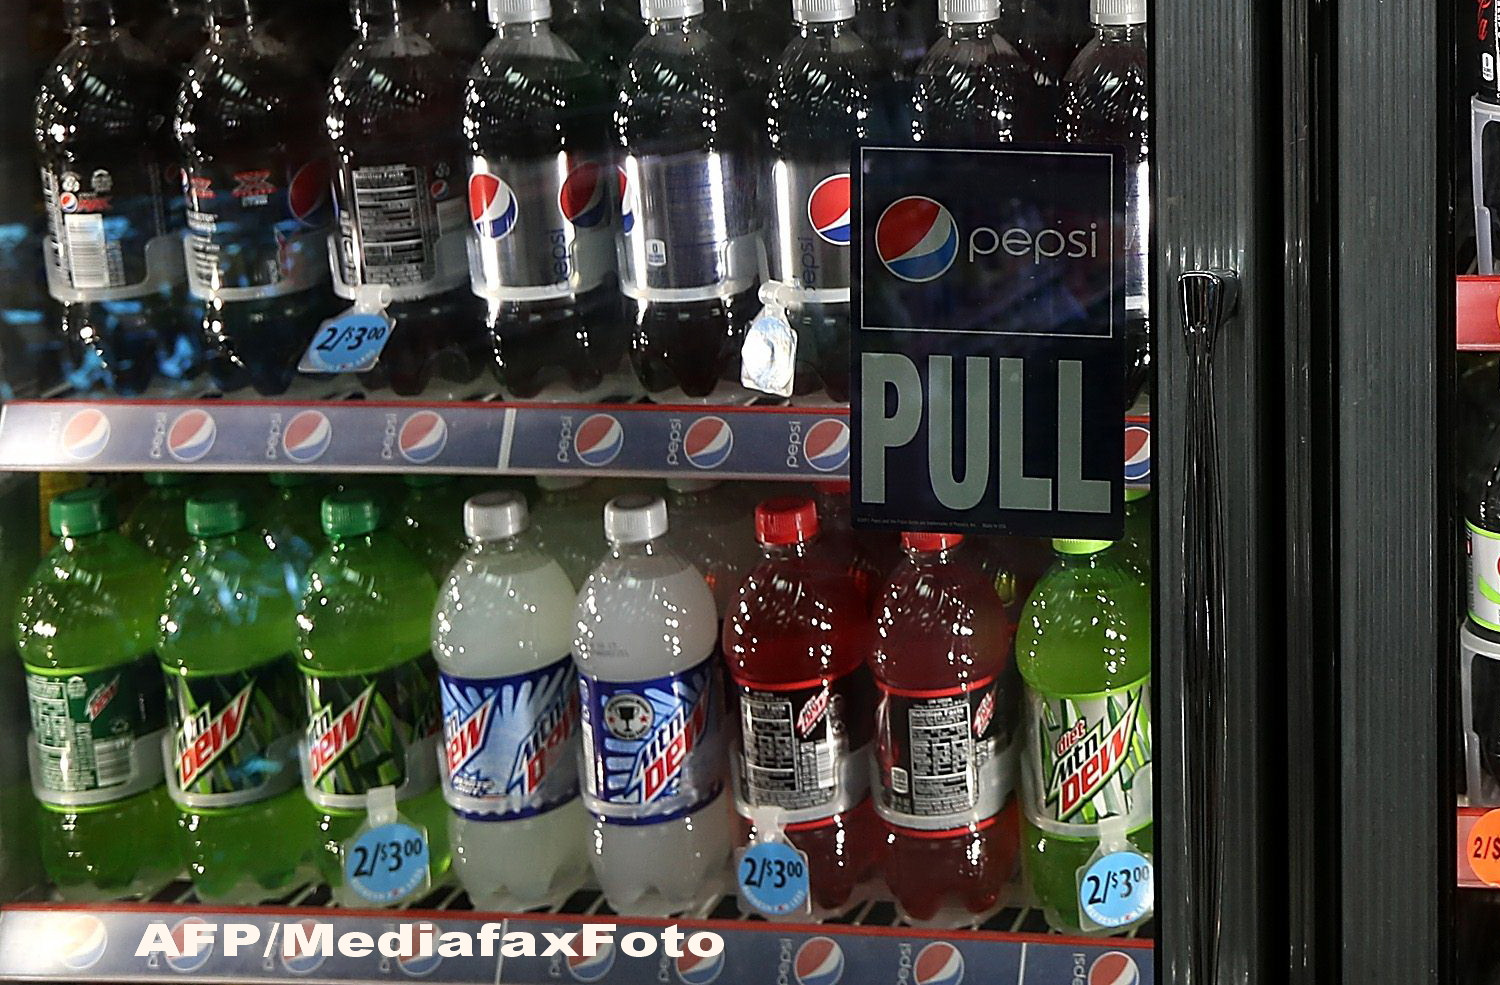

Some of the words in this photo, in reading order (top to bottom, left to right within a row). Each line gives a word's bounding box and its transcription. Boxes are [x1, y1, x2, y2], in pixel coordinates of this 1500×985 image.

[968, 222, 1098, 265] pepsi
[557, 416, 573, 463] pepsi
[666, 418, 682, 465] pepsi
[786, 420, 802, 468] pepsi
[860, 352, 1111, 514] PULL
[1052, 728, 1101, 788] Mtn
[1056, 718, 1088, 757] diet
